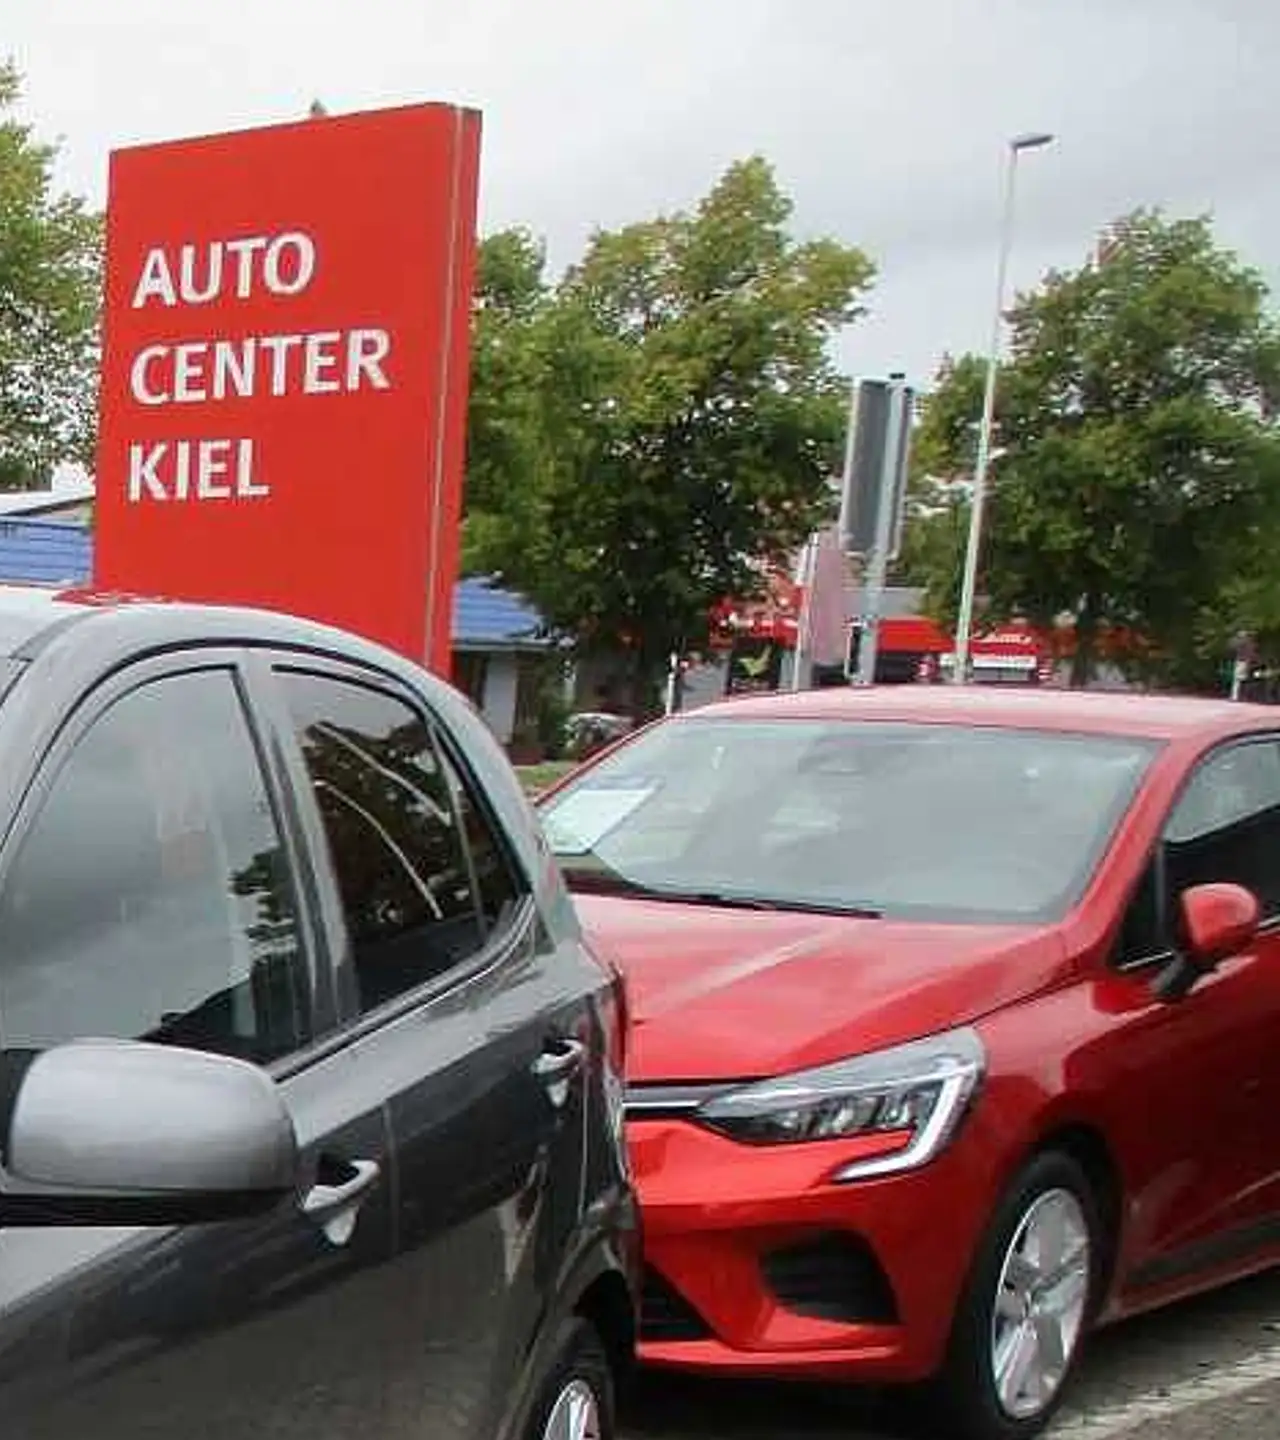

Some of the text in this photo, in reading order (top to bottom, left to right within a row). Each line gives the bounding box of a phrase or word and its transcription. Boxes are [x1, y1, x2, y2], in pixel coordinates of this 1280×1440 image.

[133, 232, 316, 308] AUTO
[130, 328, 392, 406] CENTER
[128, 438, 271, 502] KIEL
